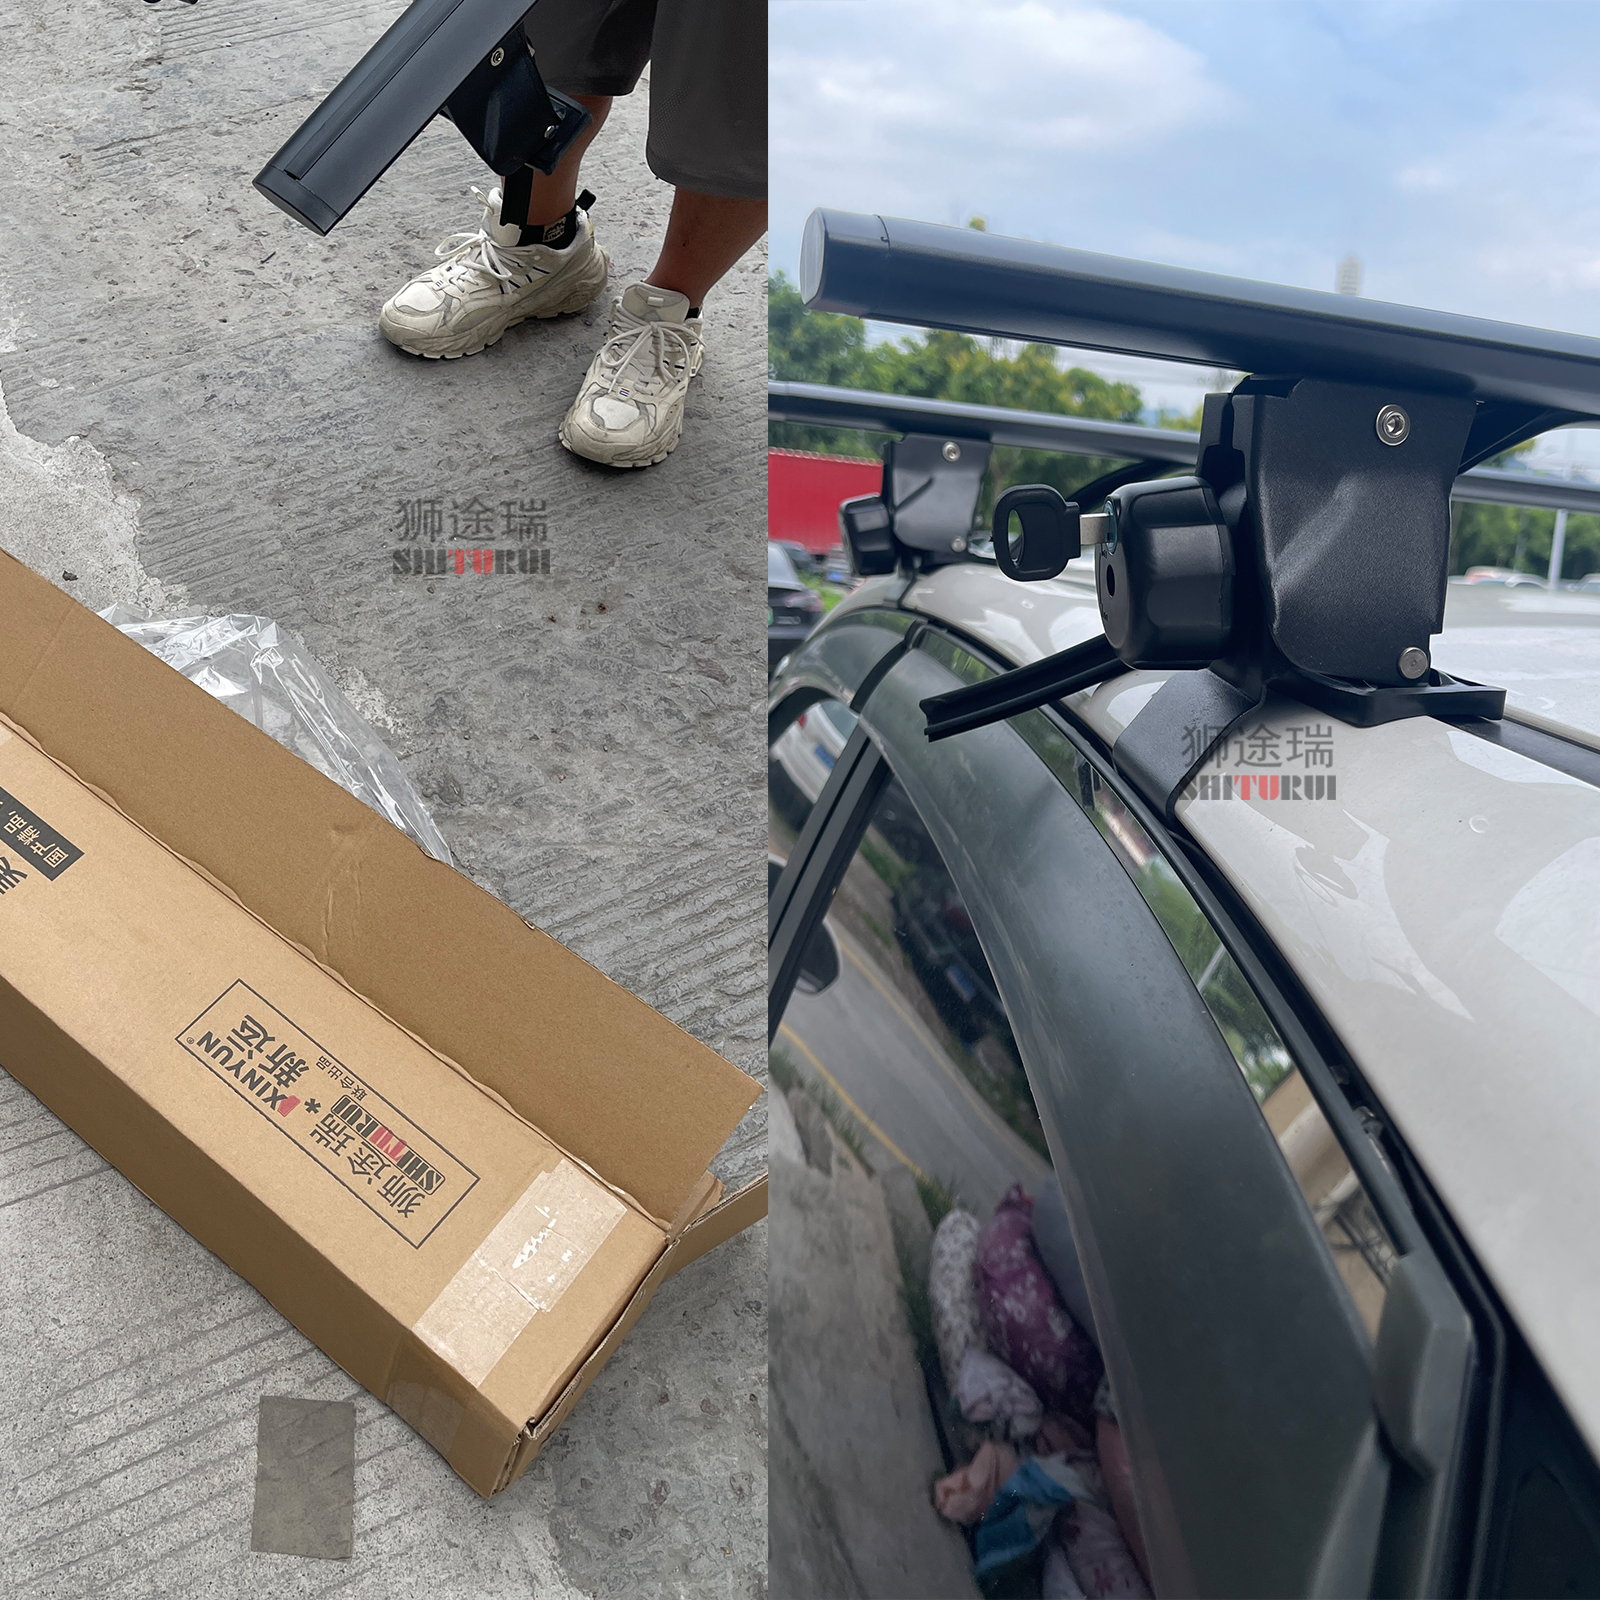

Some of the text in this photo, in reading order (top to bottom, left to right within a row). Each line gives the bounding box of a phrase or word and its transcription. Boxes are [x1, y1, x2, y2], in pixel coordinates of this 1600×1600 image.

[226, 1014, 310, 1089] 新运
[315, 1055, 368, 1102] 联合出品
[309, 1112, 426, 1219] 狮途瑞
[332, 1096, 443, 1192] SHITURUI
